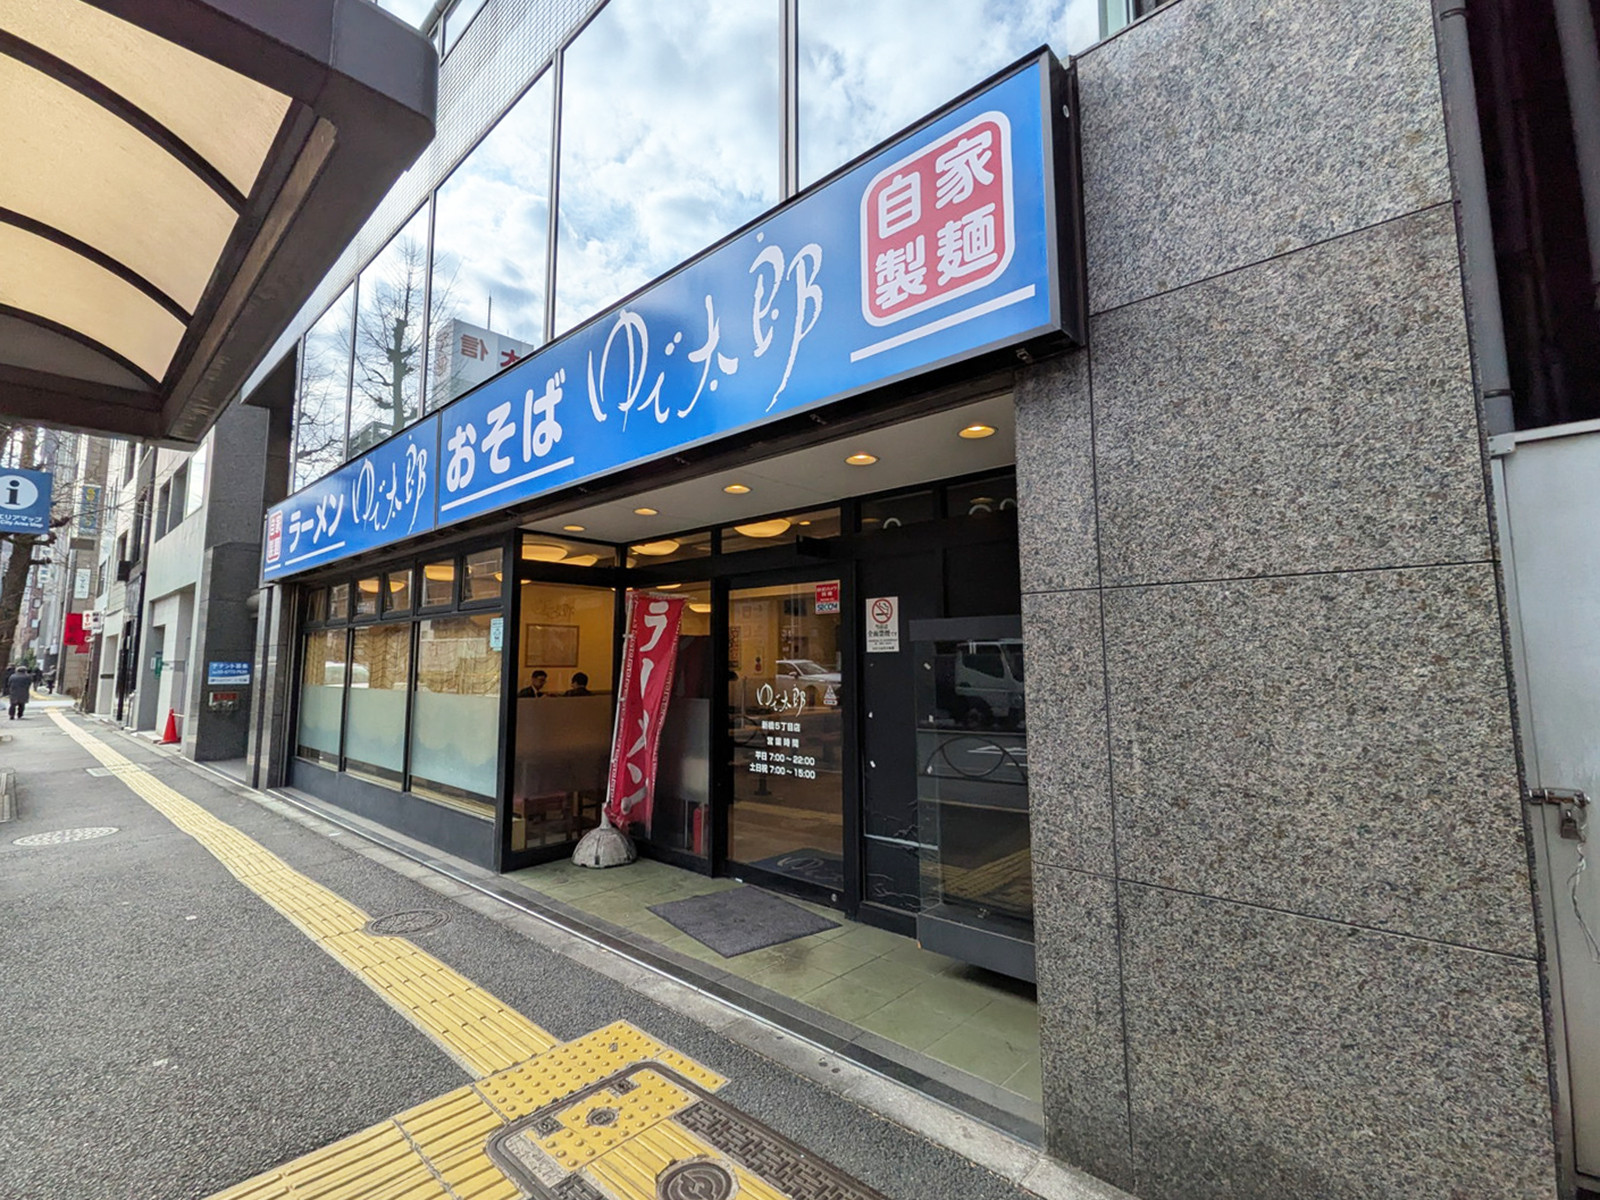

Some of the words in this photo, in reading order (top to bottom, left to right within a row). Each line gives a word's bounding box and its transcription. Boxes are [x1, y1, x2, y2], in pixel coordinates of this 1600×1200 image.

[878, 130, 995, 240] 自家
[875, 202, 998, 310] 製麺
[445, 367, 566, 493] おそば
[587, 232, 823, 432] ゆで太郎
[288, 493, 345, 554] ラーメン
[352, 434, 428, 535] ゆで太郎
[817, 602, 838, 612] SECOM
[620, 600, 669, 816] ラーメン
[756, 683, 806, 717] ゆで太郎
